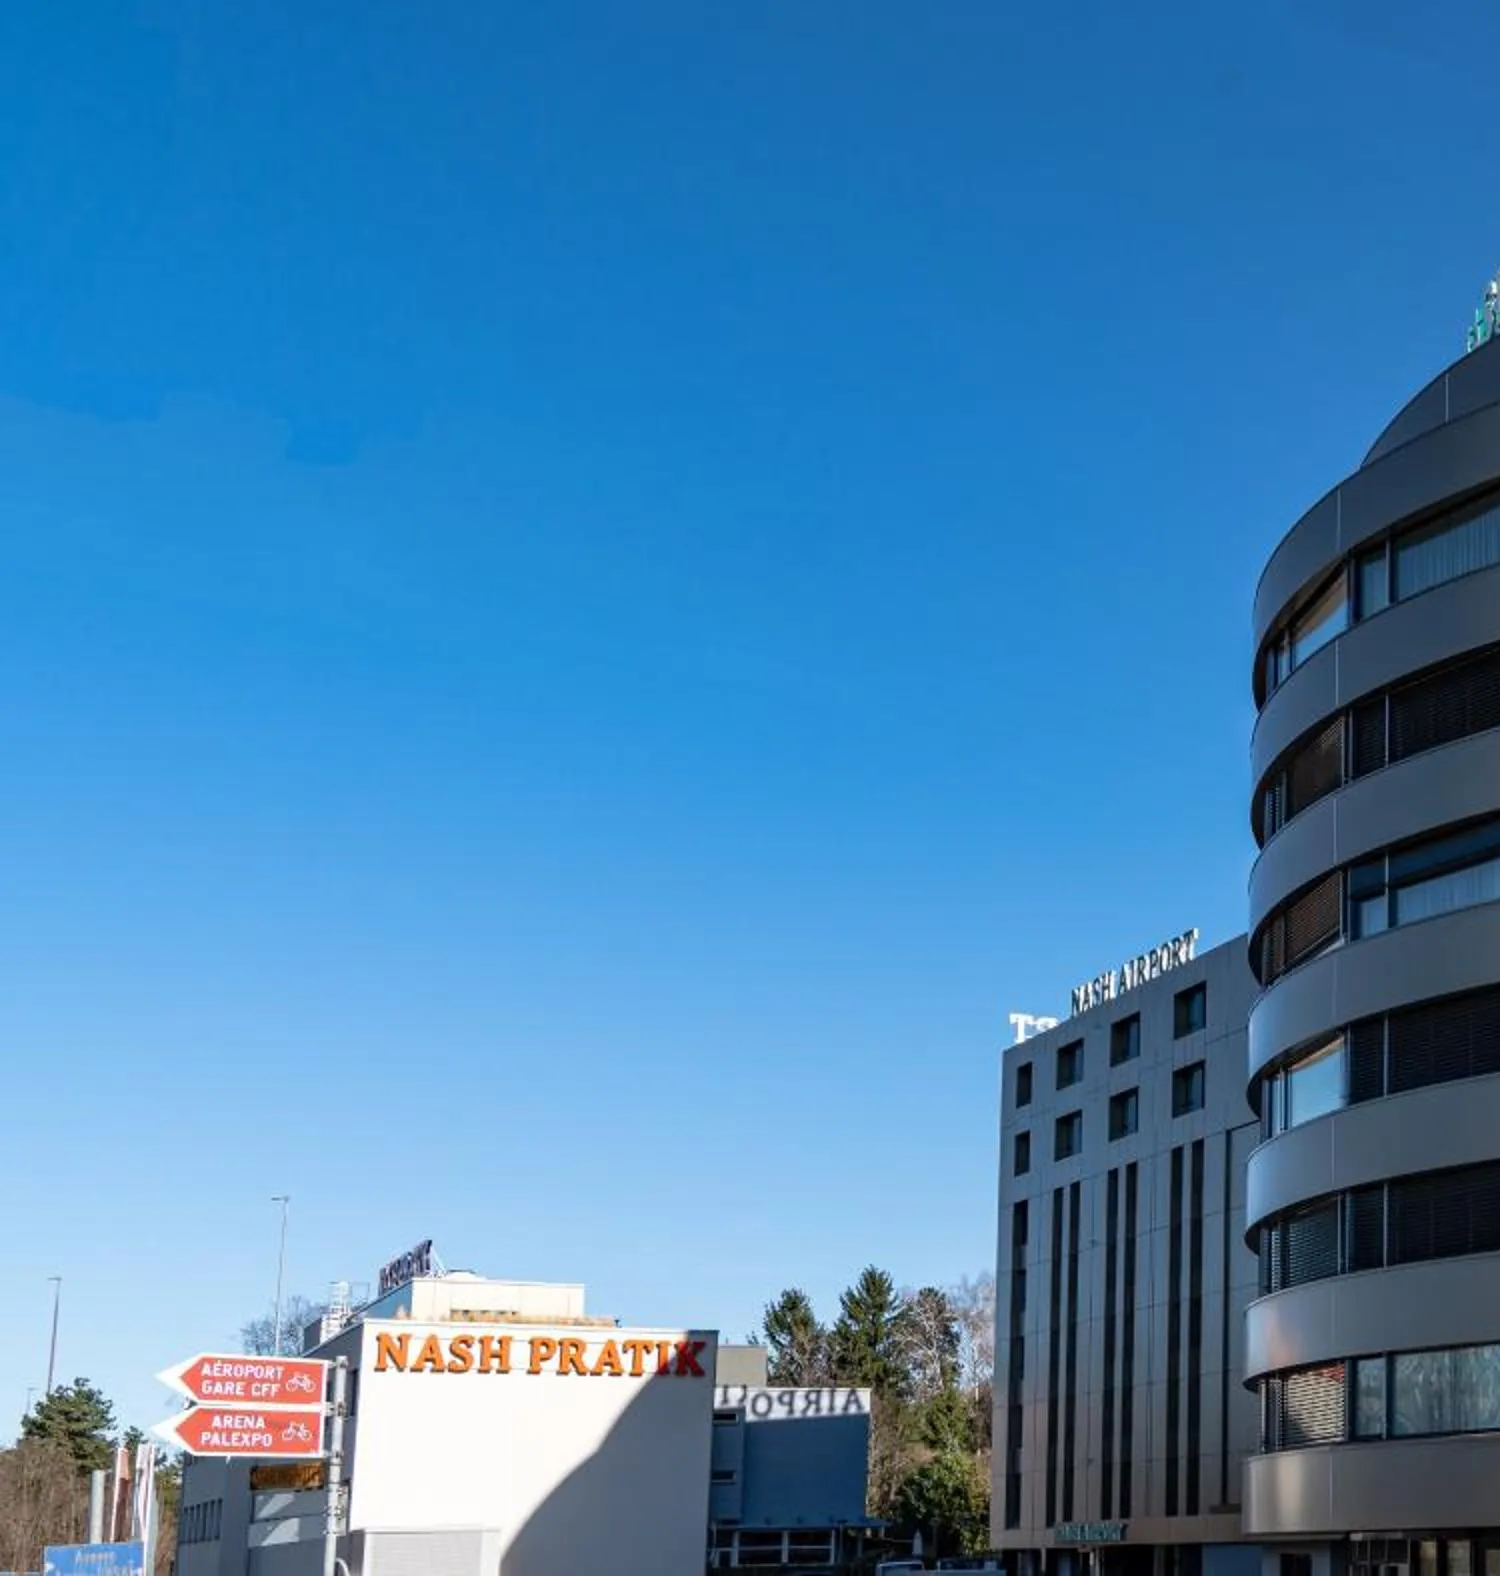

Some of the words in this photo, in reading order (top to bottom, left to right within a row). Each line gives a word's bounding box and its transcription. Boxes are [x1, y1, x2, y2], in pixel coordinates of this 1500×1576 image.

[1071, 969, 1118, 1017] NASH
[1119, 927, 1199, 996] AIRPORT
[374, 1332, 514, 1373] NASH
[526, 1337, 707, 1377] PRATIK
[201, 1360, 285, 1380] AÉROPORT
[201, 1380, 246, 1396] GARE
[251, 1382, 281, 1398] CFF
[211, 1415, 266, 1430] ARENA
[201, 1431, 273, 1448] PALEXPO
